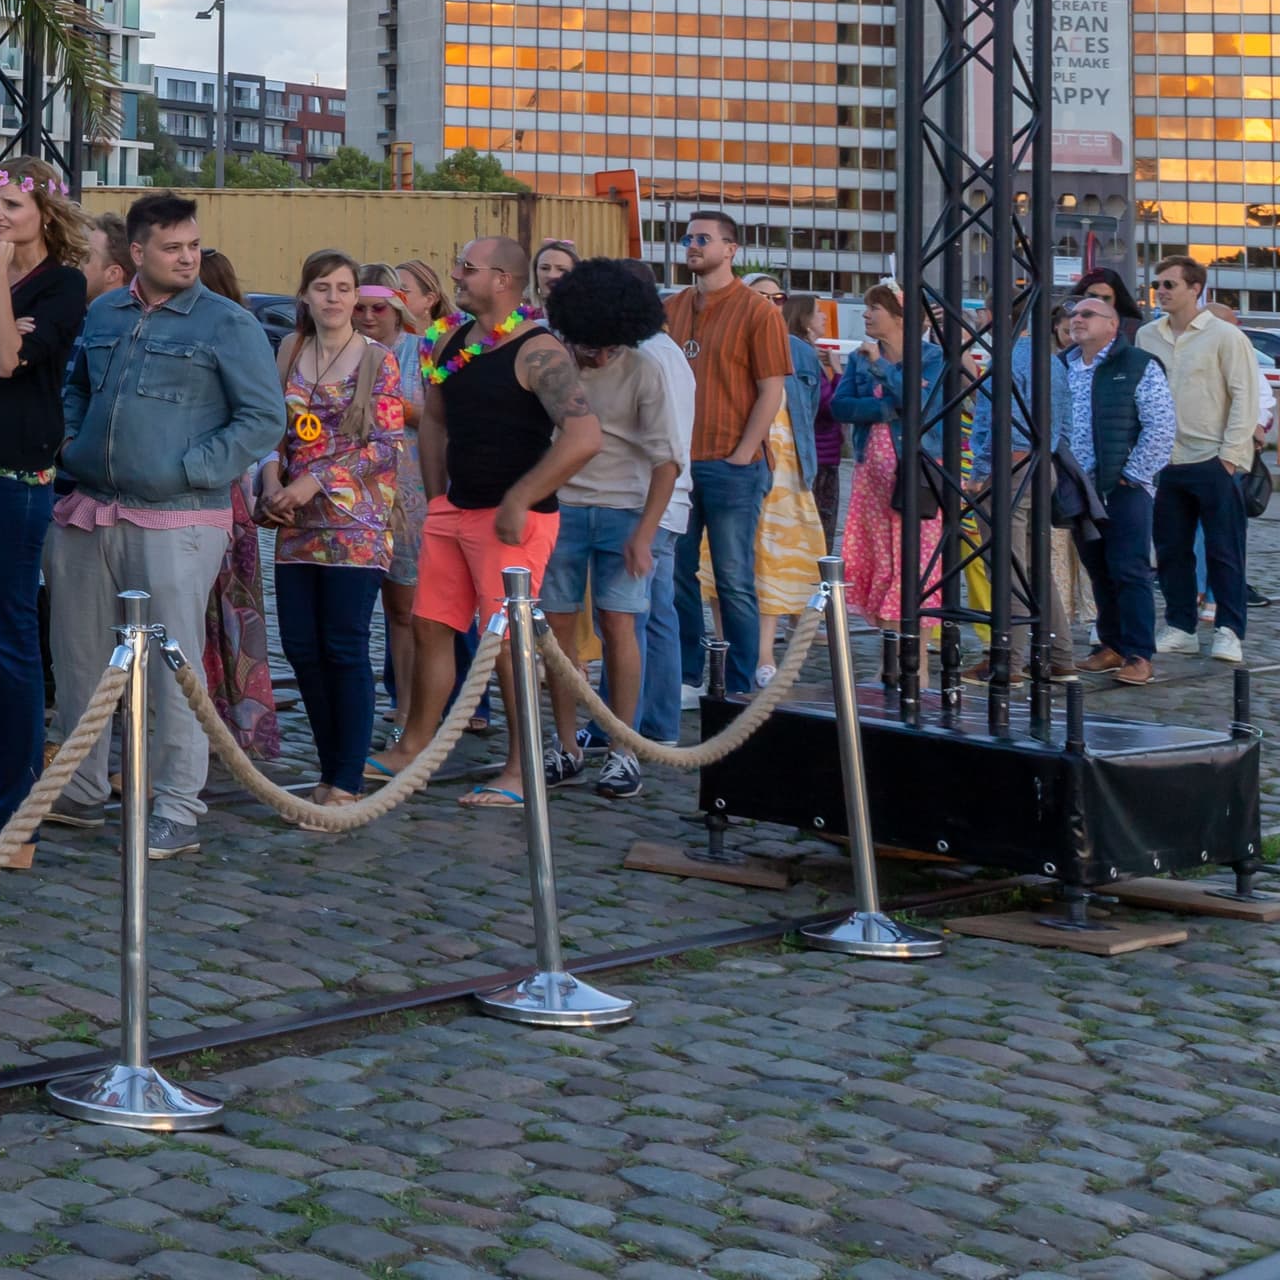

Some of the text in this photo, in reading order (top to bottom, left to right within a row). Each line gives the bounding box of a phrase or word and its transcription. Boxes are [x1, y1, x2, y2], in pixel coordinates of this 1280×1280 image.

[1052, 0, 1109, 12] CREATE
[1025, 35, 1110, 54] SACES
[1069, 57, 1110, 69] MAKE
[1052, 86, 1110, 106] APPY
